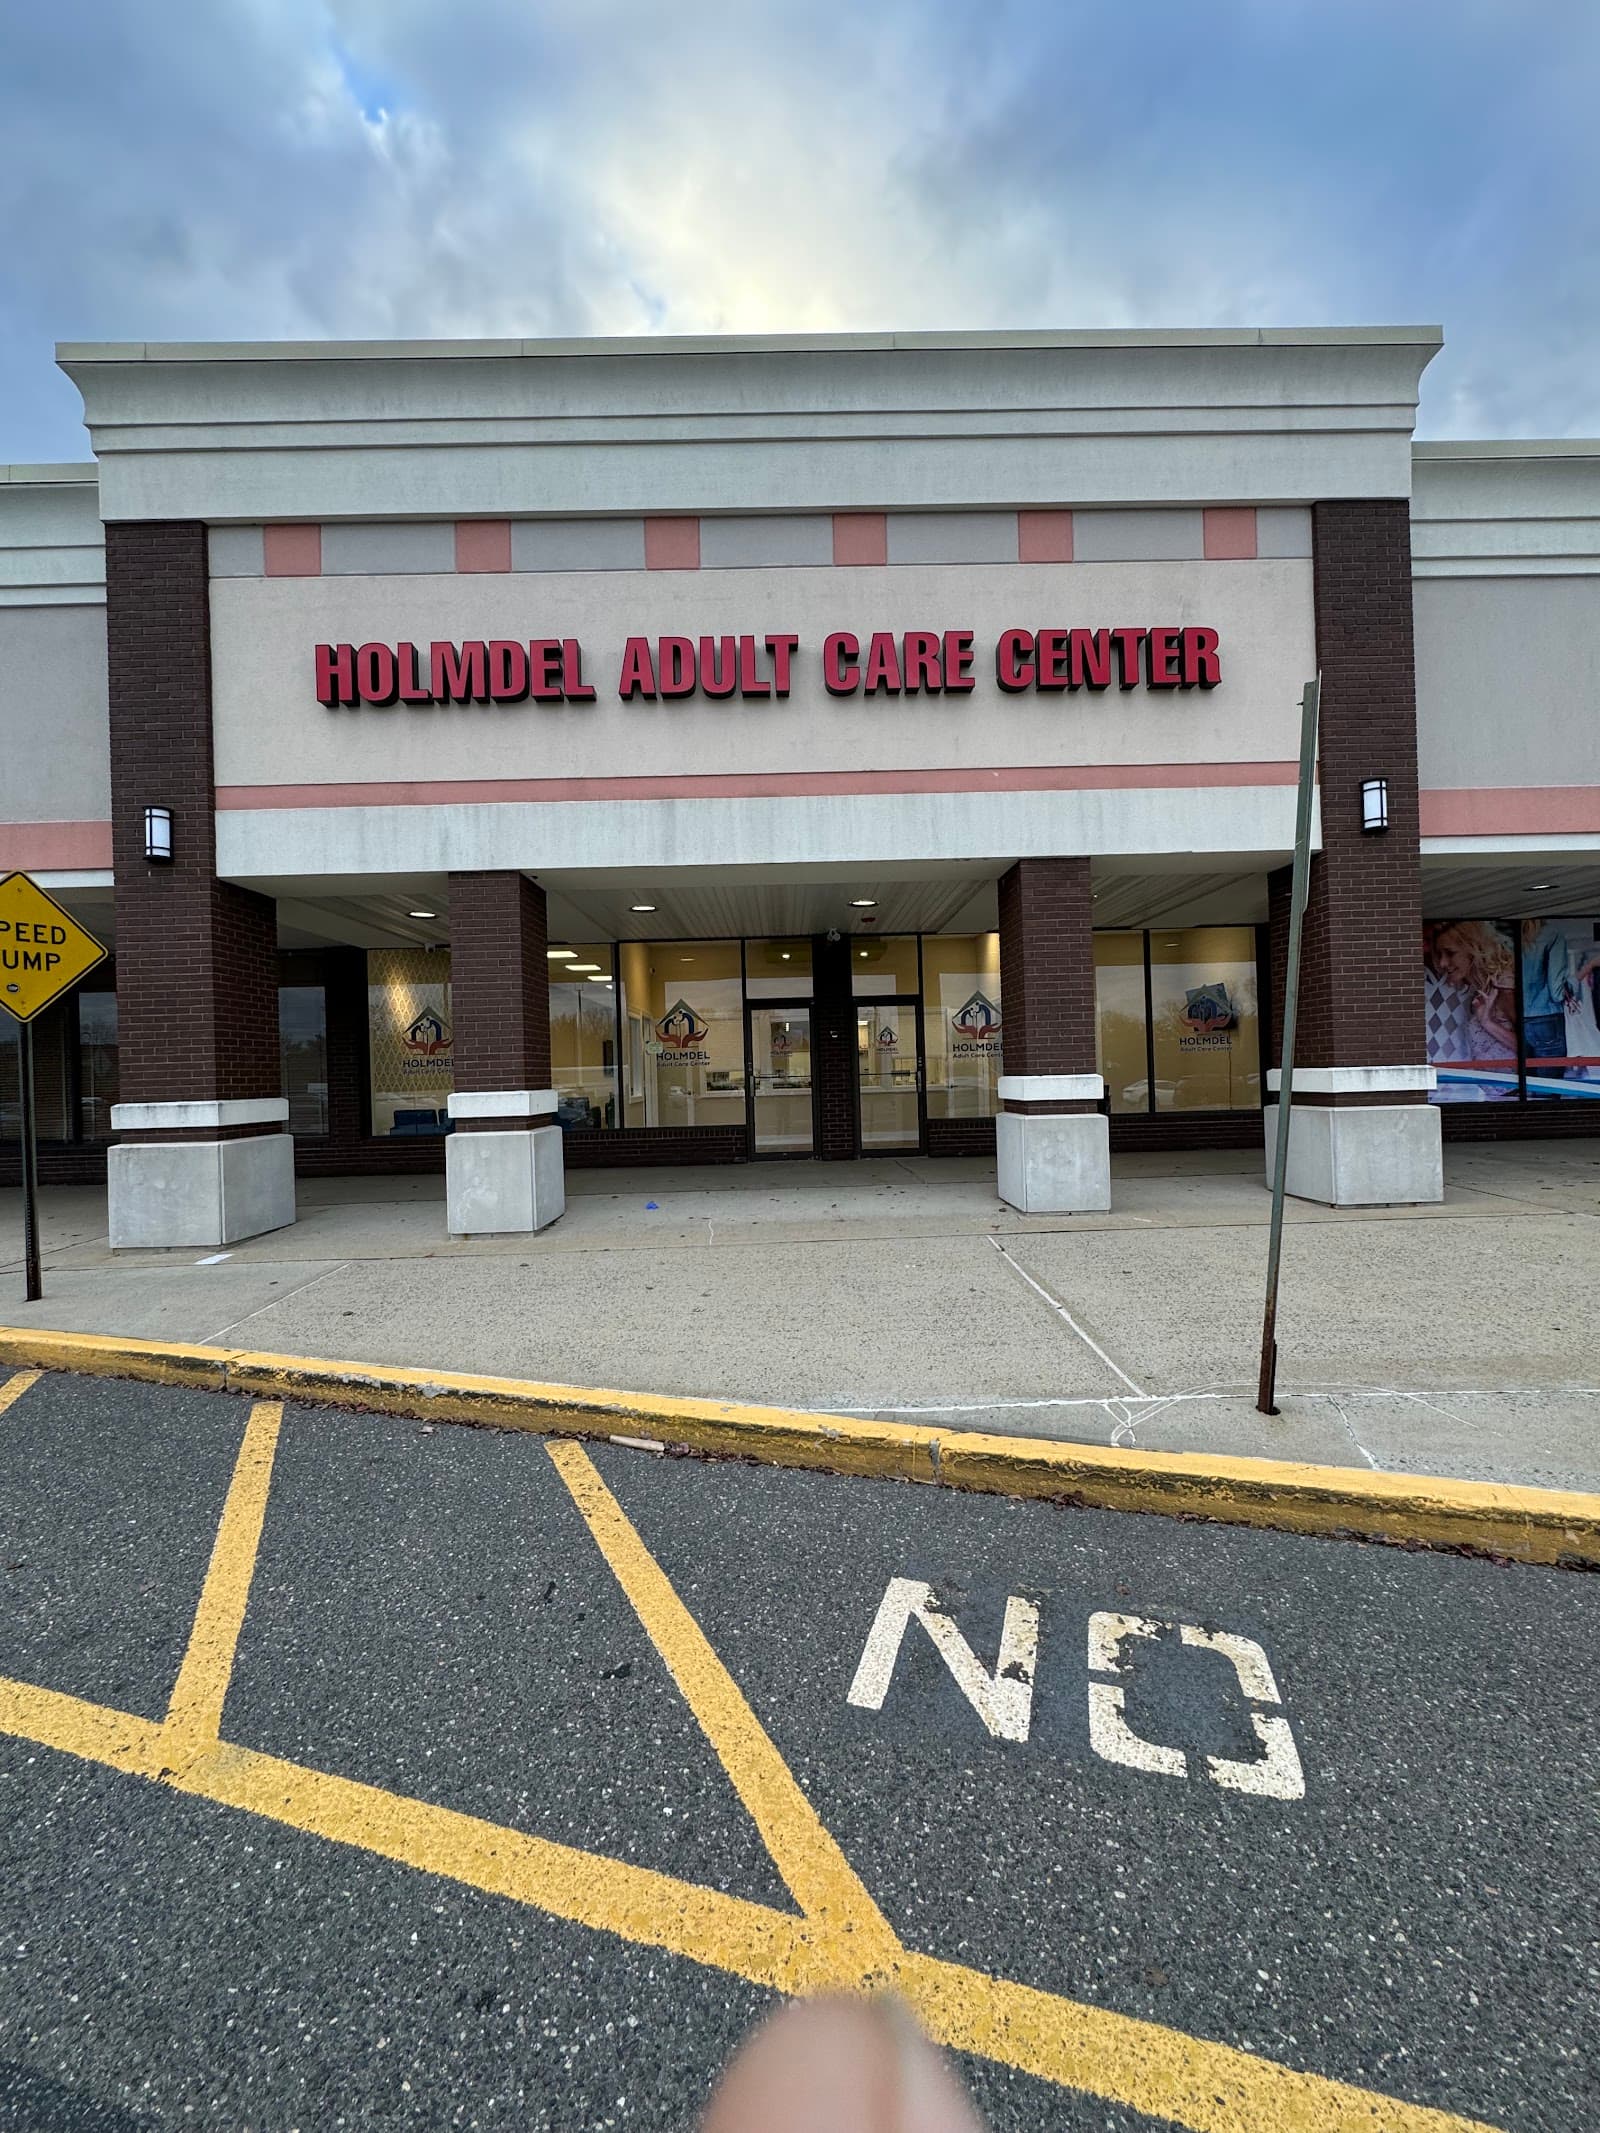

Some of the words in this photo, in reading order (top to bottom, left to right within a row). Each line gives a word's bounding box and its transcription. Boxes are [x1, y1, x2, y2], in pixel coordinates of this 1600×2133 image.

[315, 639, 597, 706] HOLMDEL
[618, 635, 798, 700] ADULT
[822, 631, 976, 696] CARE
[996, 627, 1222, 692] CENTER
[0, 920, 66, 945] PEED
[2, 949, 61, 972] UMP
[1179, 1036, 1232, 1046] HOLMDEL
[656, 1051, 711, 1061] HOLMDEL
[846, 1577, 1306, 1800] NO
